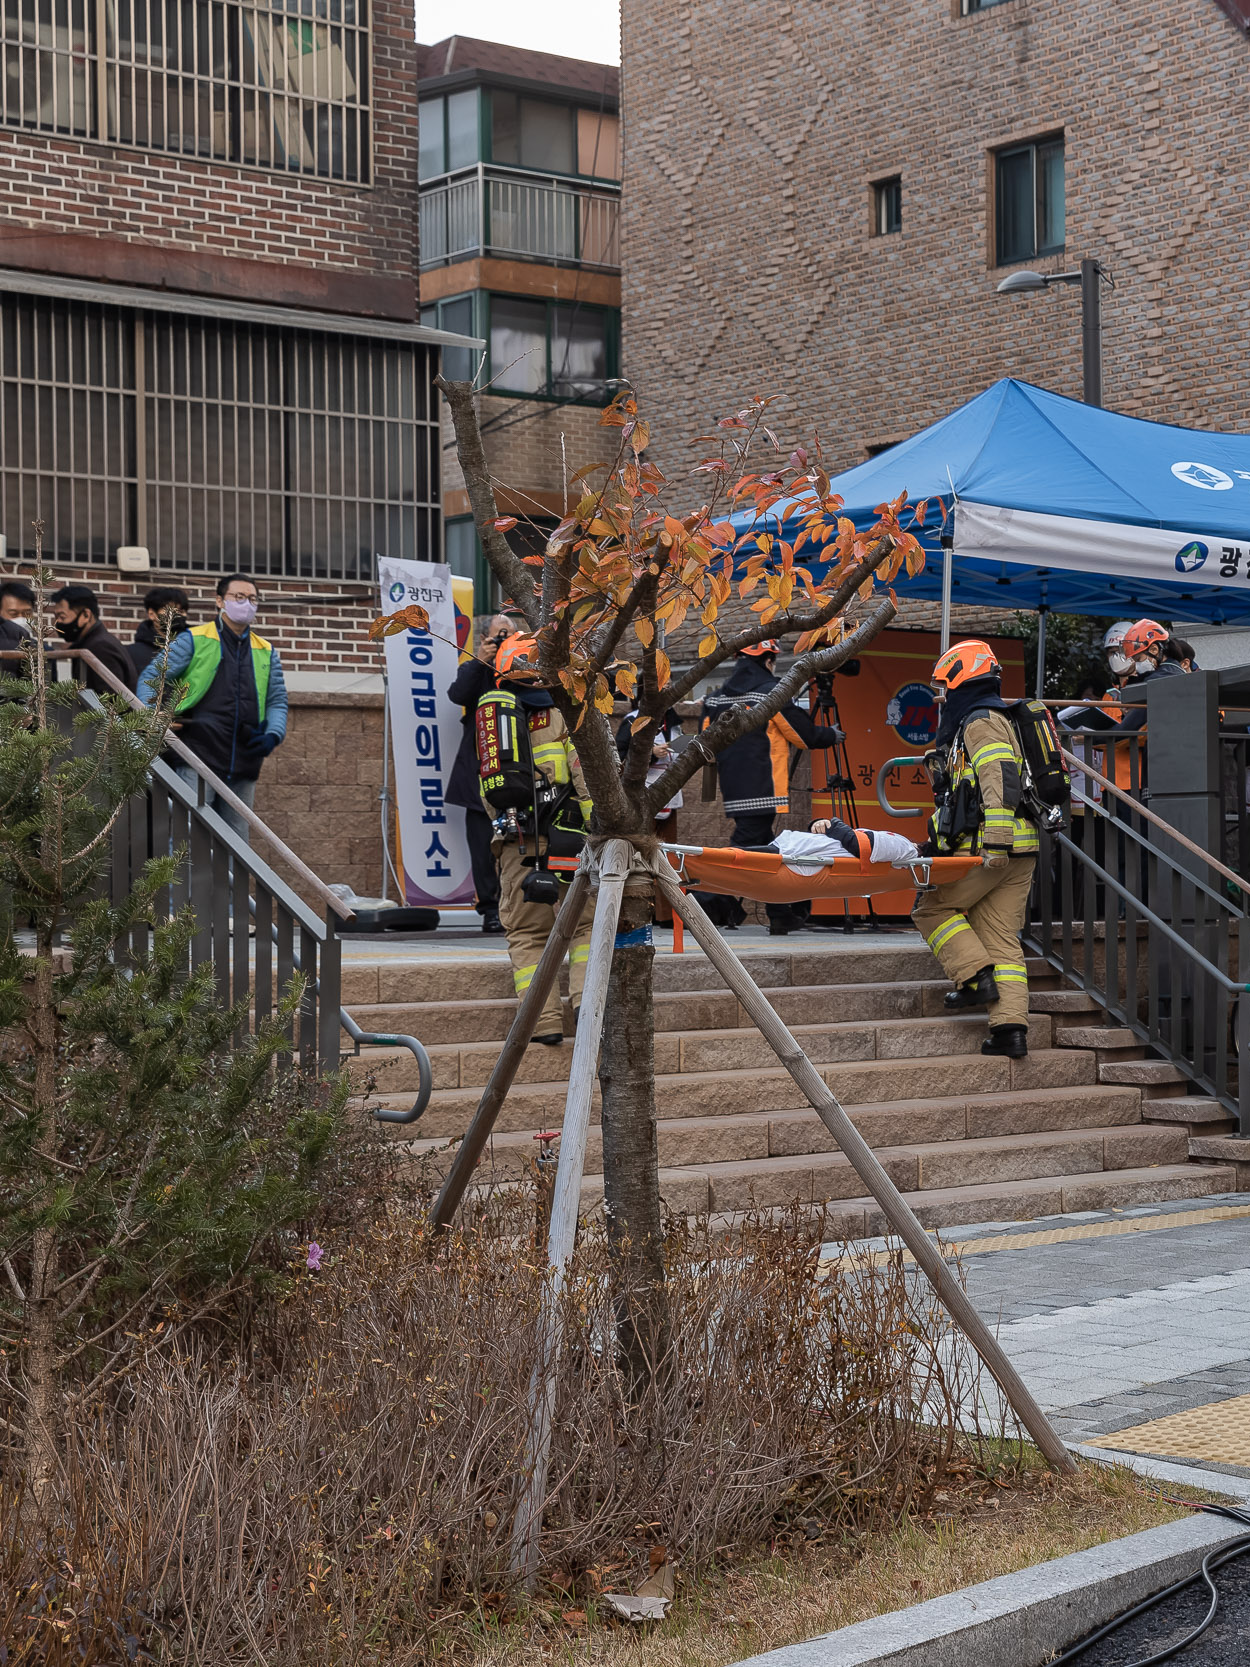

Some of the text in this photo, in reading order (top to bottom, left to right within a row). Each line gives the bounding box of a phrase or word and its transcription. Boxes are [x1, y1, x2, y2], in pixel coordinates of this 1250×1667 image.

[407, 585, 445, 603] 광진구
[406, 622, 452, 878] 응급의료소
[484, 705, 499, 769] 광진소방서
